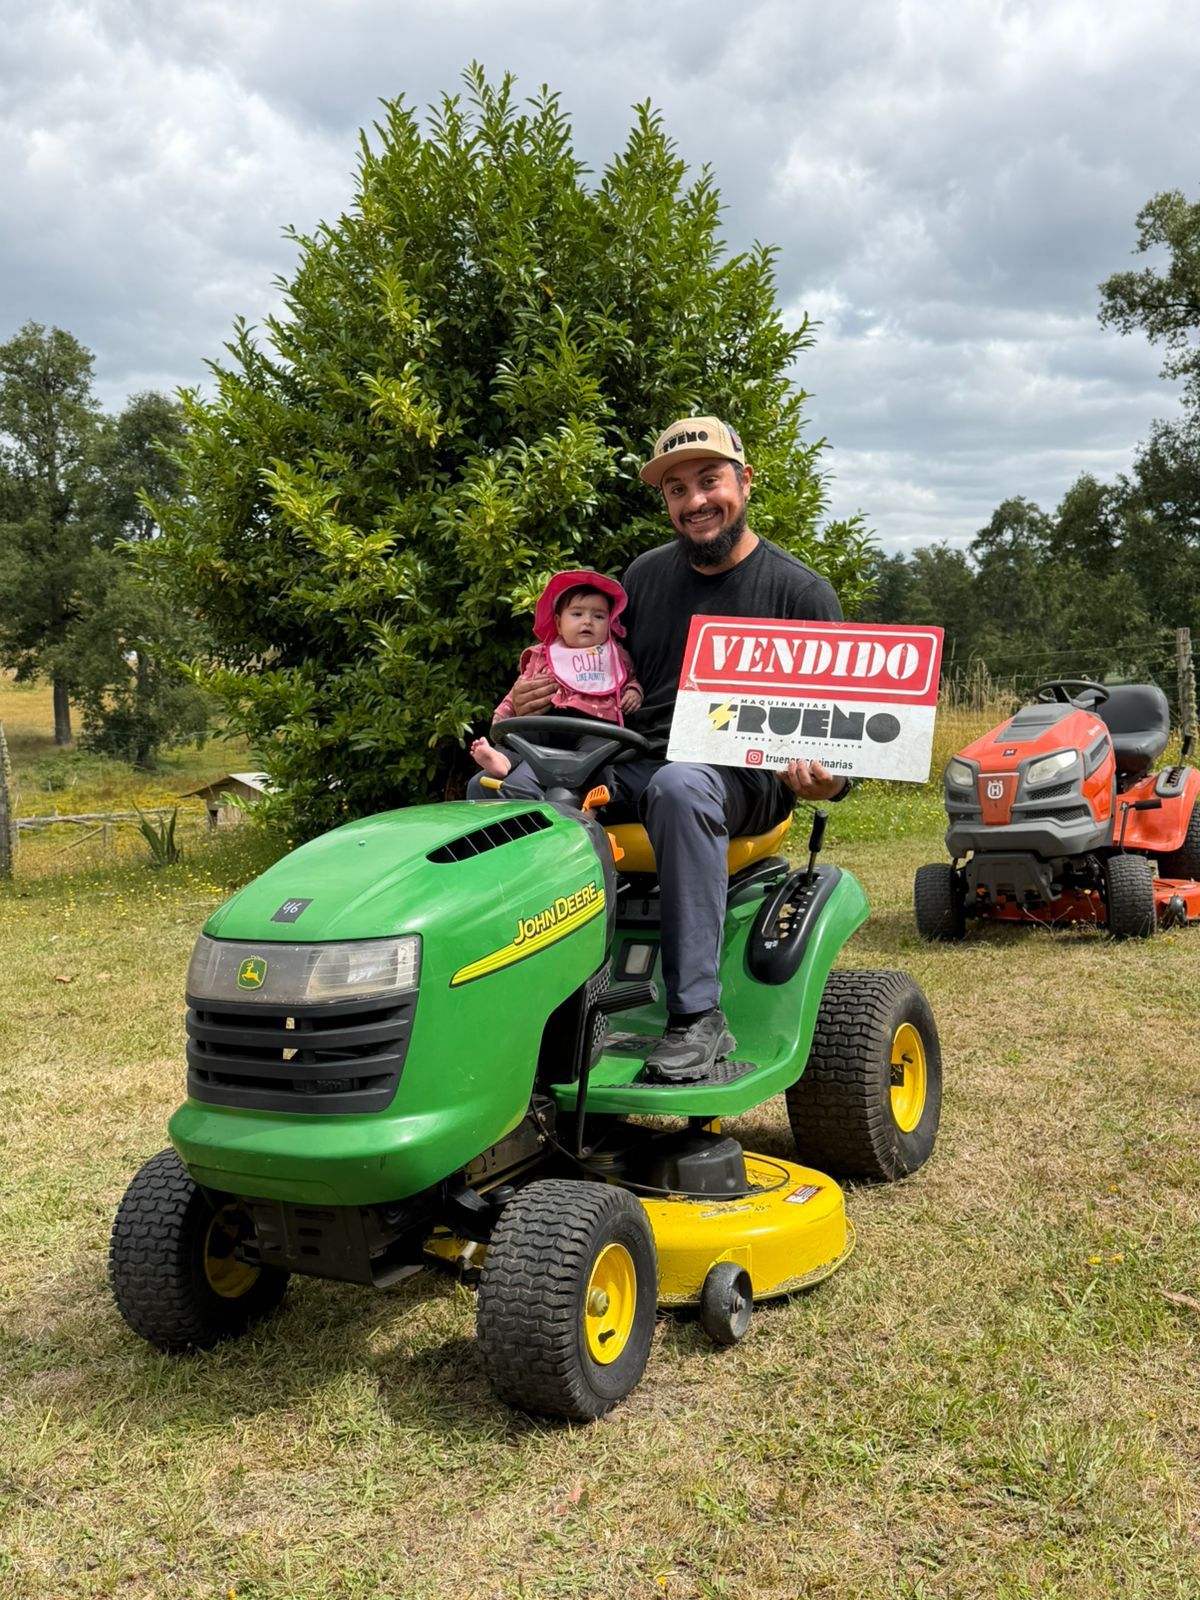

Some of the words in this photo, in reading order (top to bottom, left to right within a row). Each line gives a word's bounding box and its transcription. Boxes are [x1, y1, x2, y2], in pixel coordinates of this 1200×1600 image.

[572, 652, 605, 673] CUTE
[711, 634, 919, 680] VENDIDO
[741, 698, 828, 710] MAQUINARIAS
[707, 702, 901, 744] TRUENO
[283, 902, 303, 914] 46
[514, 907, 557, 946] JOHN
[554, 880, 598, 921] DEERE
